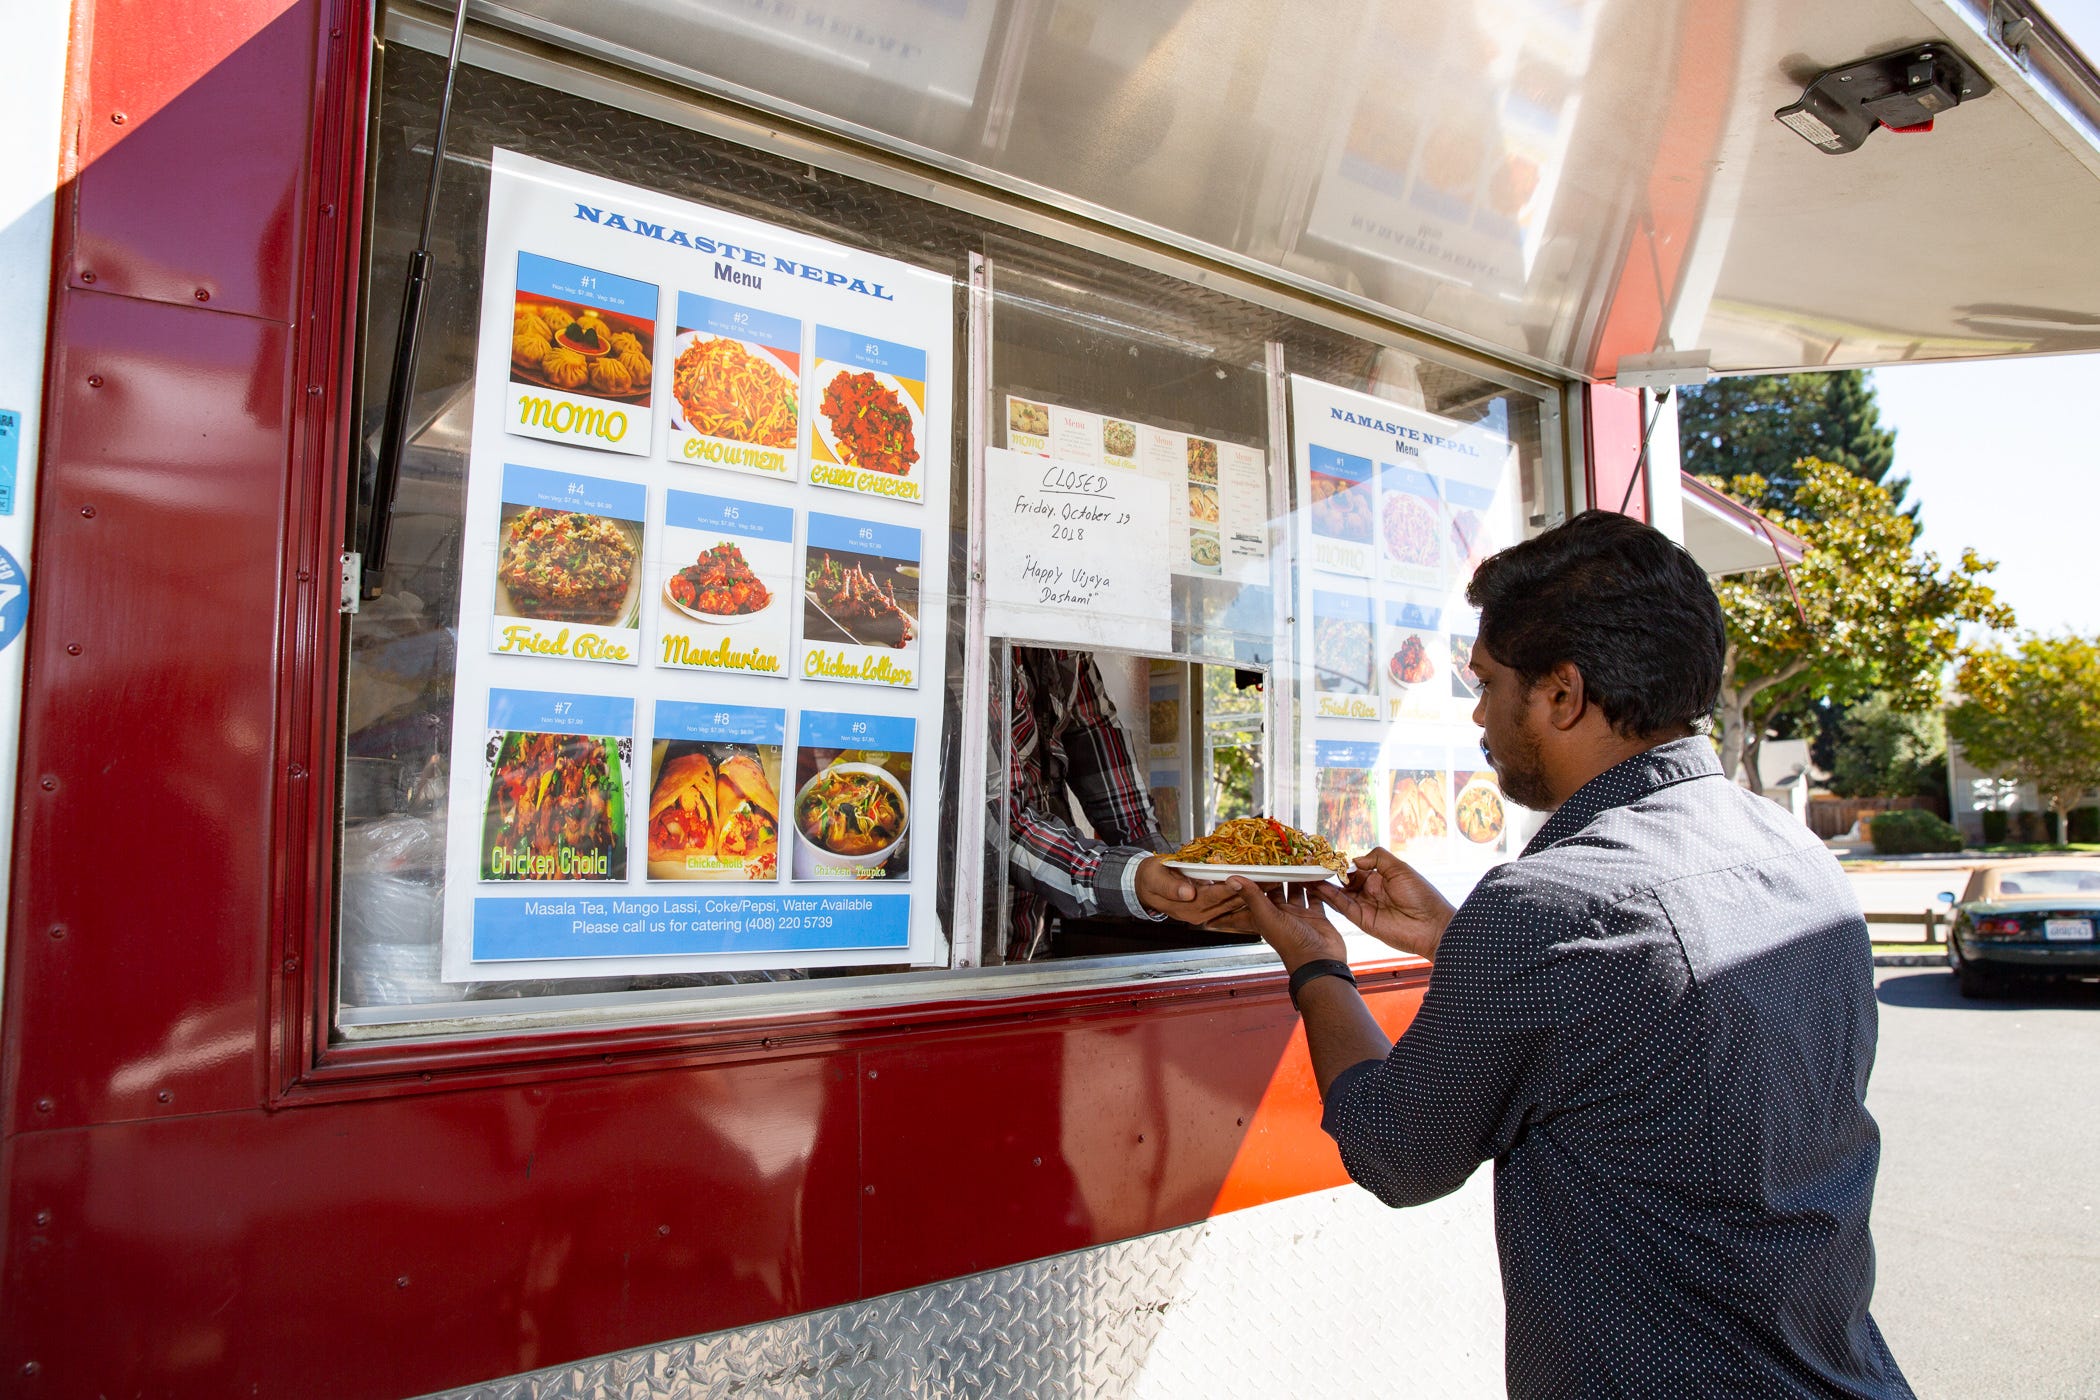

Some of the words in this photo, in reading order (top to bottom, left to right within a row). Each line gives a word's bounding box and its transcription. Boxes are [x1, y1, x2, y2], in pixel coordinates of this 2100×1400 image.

[574, 203, 765, 267] NAMASTE
[773, 257, 893, 301] NEPAL
[580, 275, 596, 290] #1
[714, 262, 762, 290] Menu
[733, 312, 749, 326] #2
[866, 343, 879, 356] #3
[1330, 407, 1420, 440] NAMASTE
[1422, 432, 1480, 457] NEPAL
[1395, 440, 1419, 457] Menu
[857, 473, 920, 499] CHICKEN
[1043, 466, 1108, 493] CLOSED
[567, 482, 584, 496] #4
[724, 506, 739, 519] #5
[1062, 503, 1111, 520] October
[1116, 513, 1131, 525] 19
[859, 528, 873, 540] #6
[1051, 524, 1084, 541] 2018
[498, 625, 569, 655] Fried
[573, 633, 630, 660] Rice
[662, 634, 780, 672] Manchurian
[804, 649, 859, 679] Chicken
[859, 655, 912, 685] Lollipop
[554, 702, 573, 715] #7
[714, 713, 729, 725] #8
[852, 722, 866, 734] #9
[492, 846, 555, 875] Chicken
[560, 847, 608, 875] Choila
[687, 857, 720, 869] Chicken
[723, 857, 743, 869] Rolls
[525, 902, 576, 915] Masala
[580, 901, 608, 916] Tea,
[613, 901, 659, 917] Mango
[664, 900, 701, 915] Lassi,
[705, 900, 779, 914] Coke/Pepsi,
[783, 899, 817, 911] Water
[820, 899, 873, 911] Available
[572, 920, 619, 934] Please
[623, 920, 646, 933] call
[650, 922, 666, 932] us
[669, 919, 688, 932] for
[691, 918, 742, 933] catering
[745, 917, 776, 932] (408)
[778, 917, 800, 929] 220
[803, 916, 833, 929] 5739
